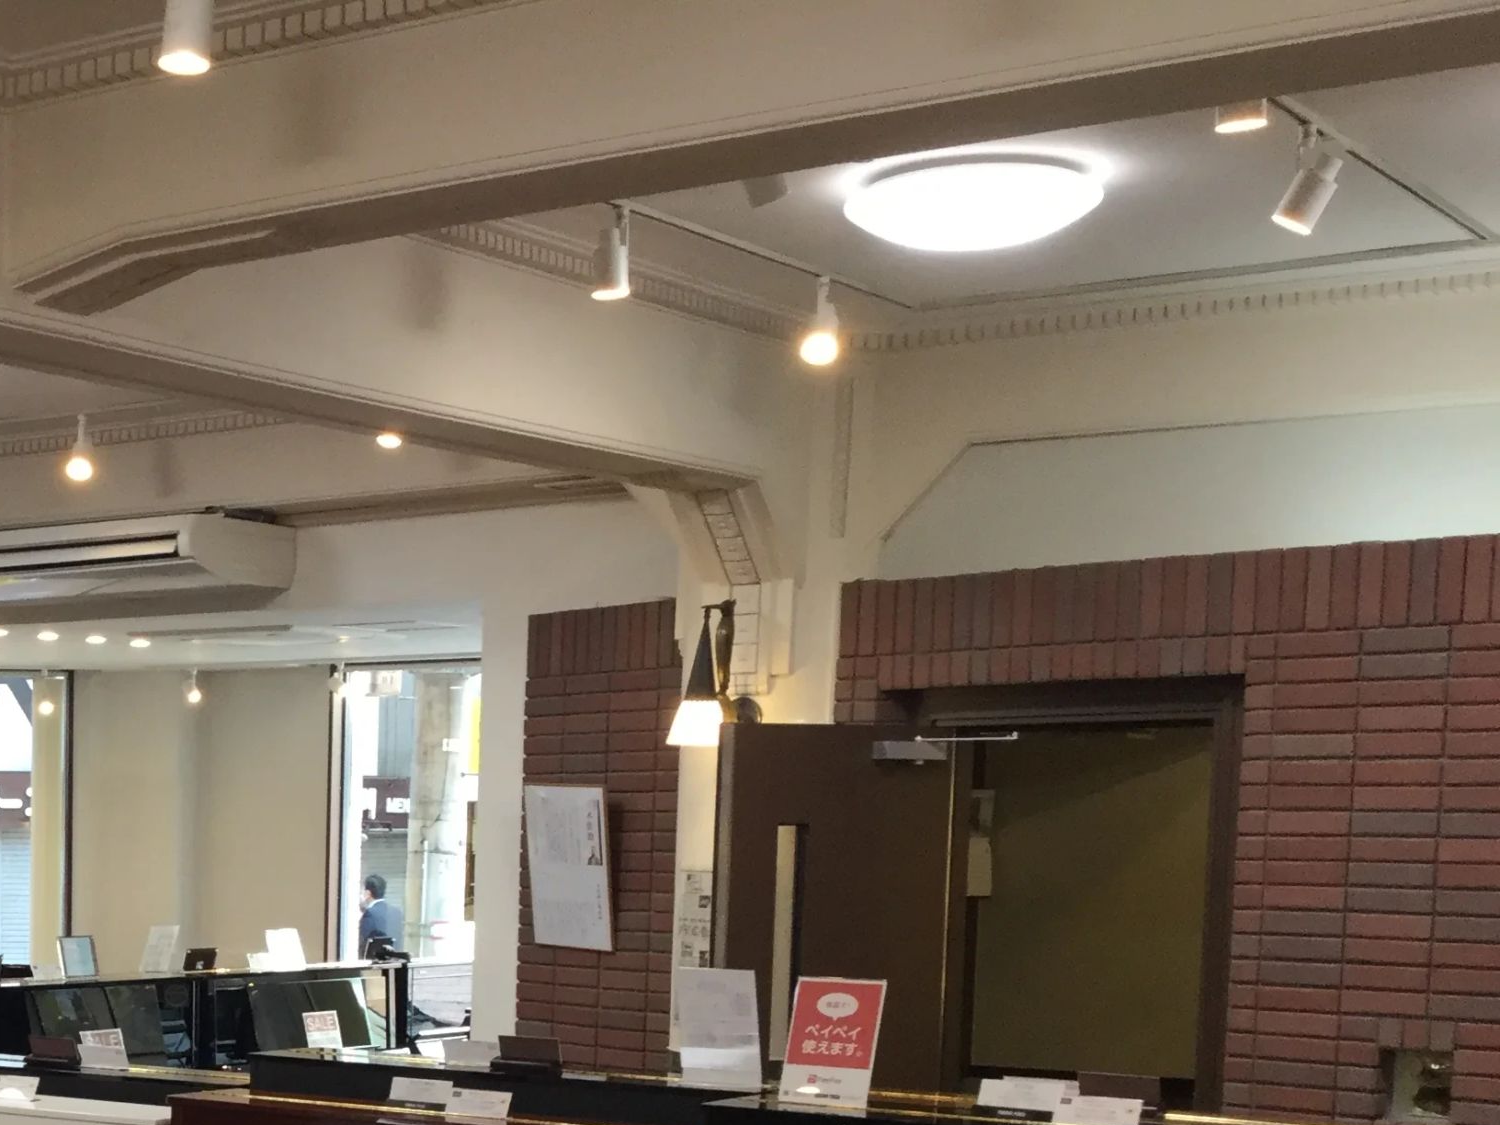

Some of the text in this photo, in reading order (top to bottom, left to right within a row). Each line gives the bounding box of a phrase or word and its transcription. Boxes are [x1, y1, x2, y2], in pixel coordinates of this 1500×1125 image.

[307, 1015, 336, 1032] SALE
[804, 1023, 862, 1041] ペイペイ
[802, 1039, 864, 1057] 使えます。
